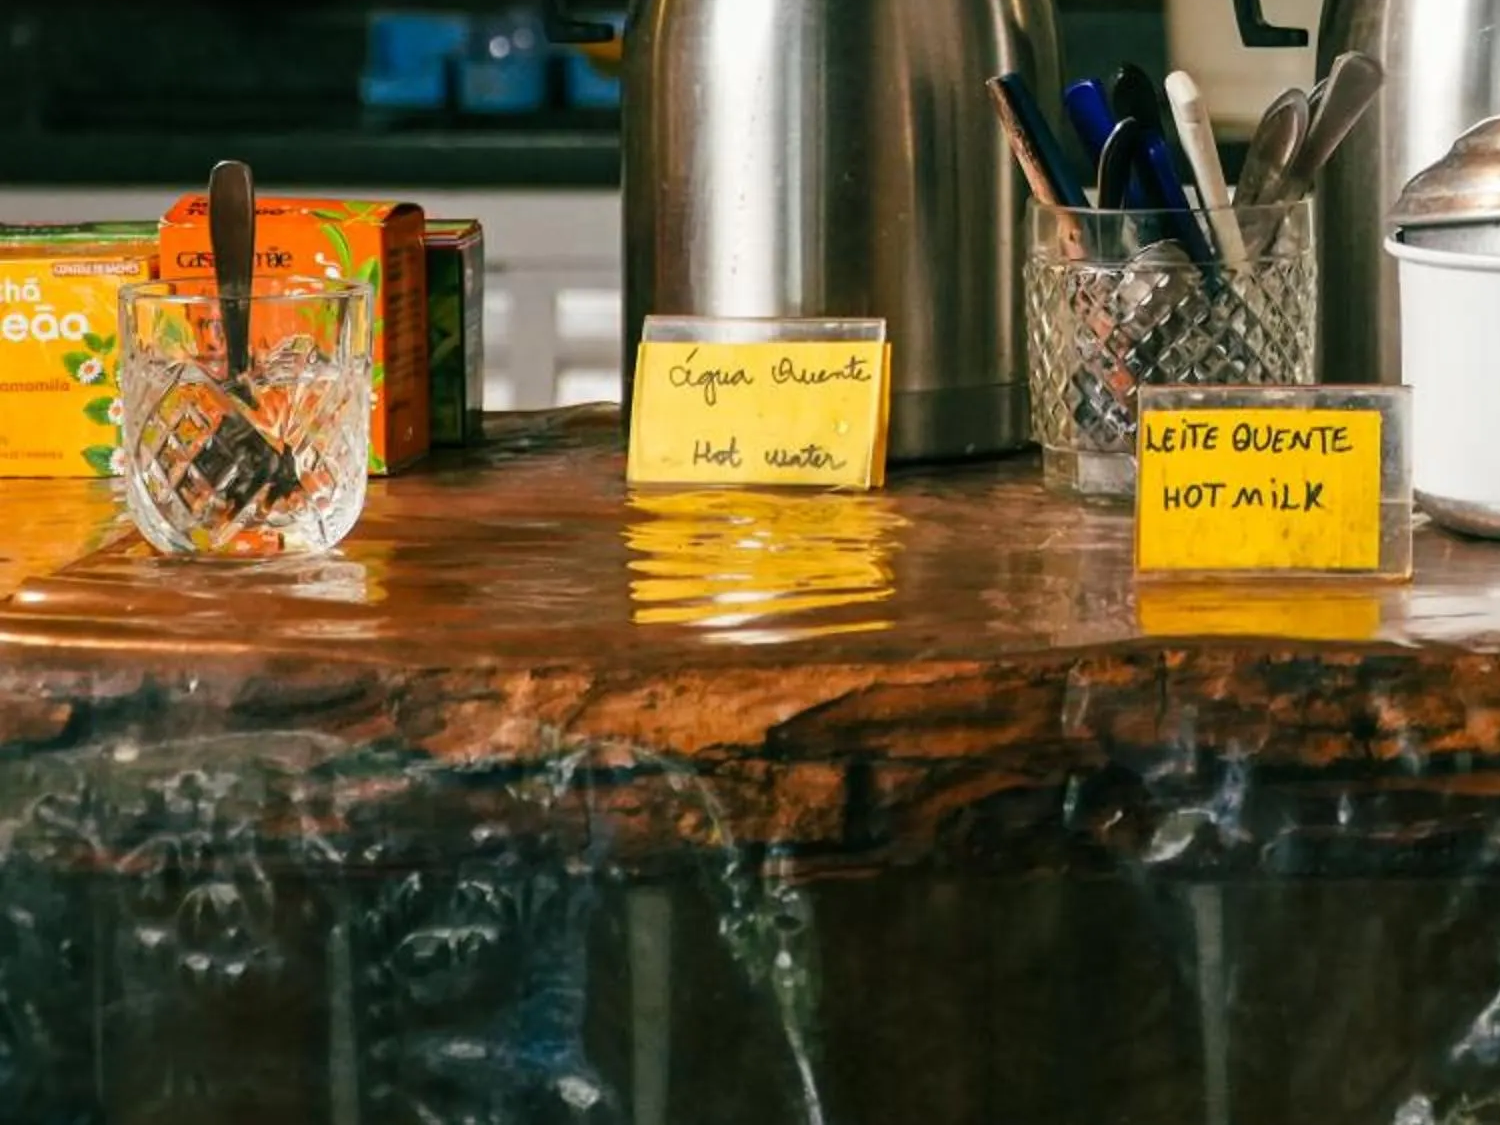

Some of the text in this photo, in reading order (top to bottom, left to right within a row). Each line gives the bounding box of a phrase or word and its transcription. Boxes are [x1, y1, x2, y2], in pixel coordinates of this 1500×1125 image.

[692, 436, 743, 469] Hot
[1231, 422, 1353, 455] QUENTE
[1163, 481, 1227, 511] HOT
